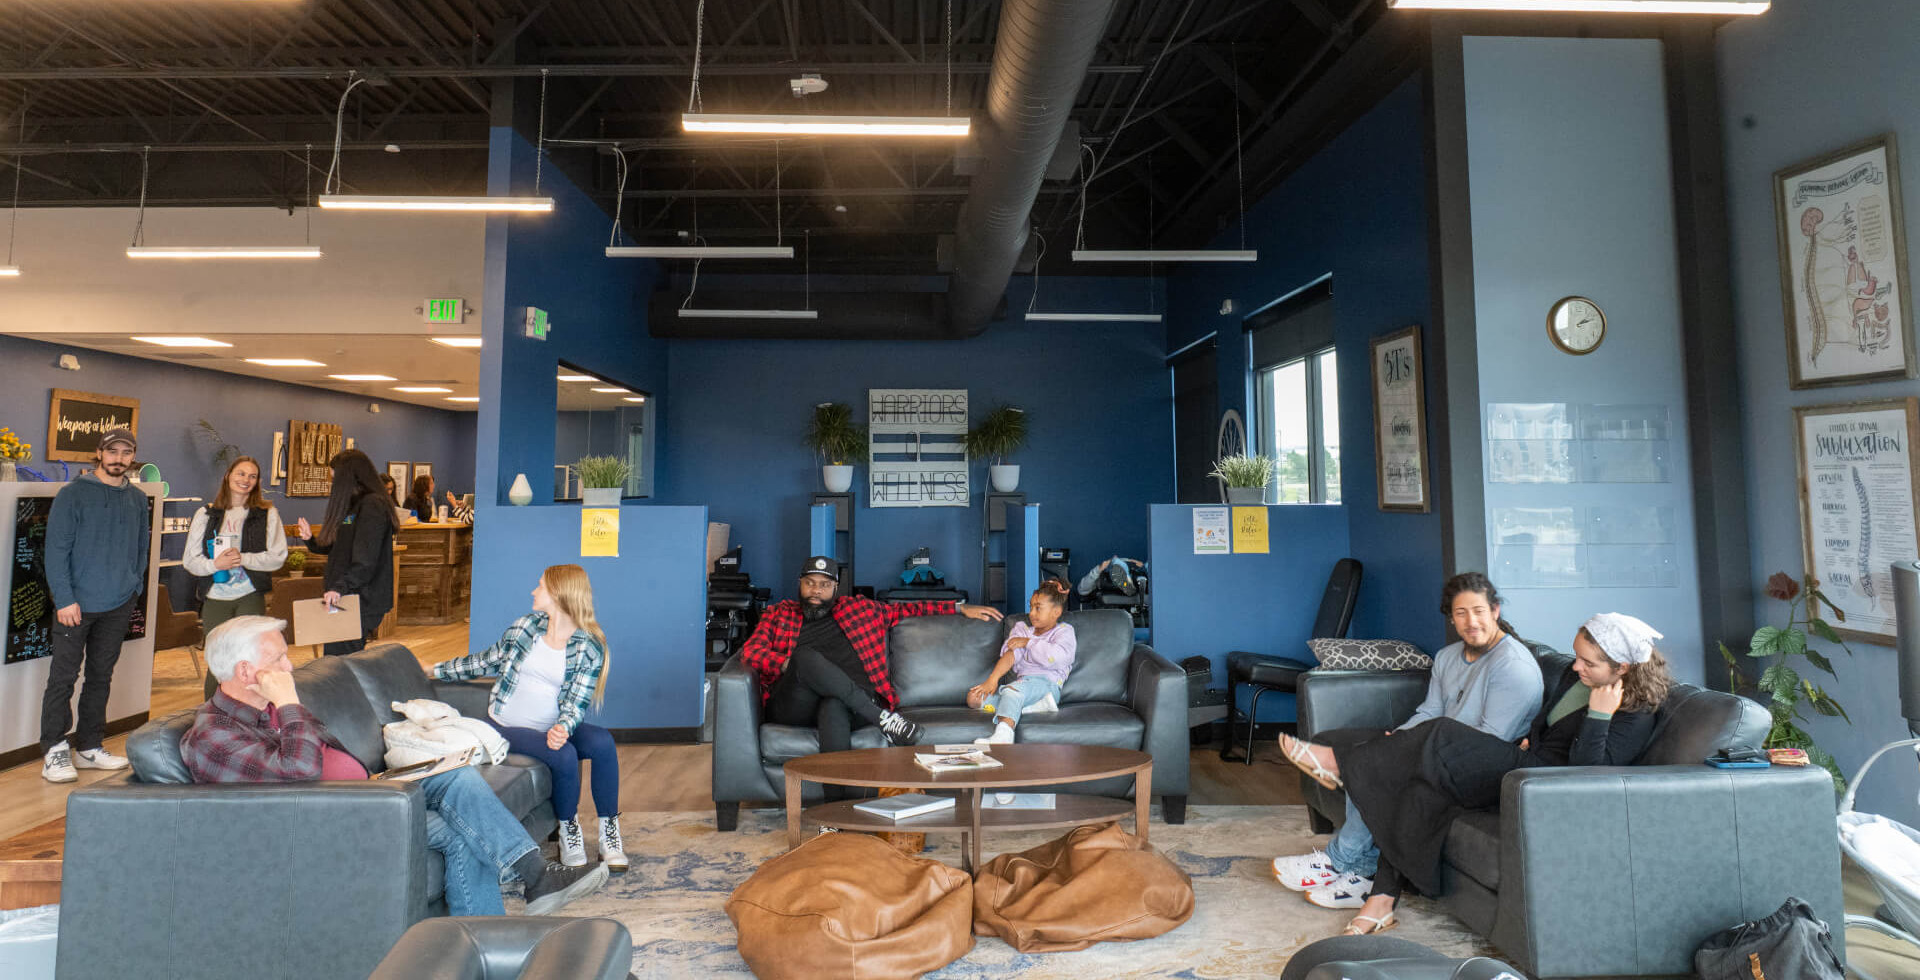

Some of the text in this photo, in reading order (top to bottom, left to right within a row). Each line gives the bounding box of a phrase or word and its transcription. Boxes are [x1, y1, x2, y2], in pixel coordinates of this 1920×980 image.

[430, 299, 457, 320] EXIT
[871, 394, 967, 424] WARRIORS
[57, 414, 92, 442] Weapons
[300, 431, 342, 465] WOW
[303, 467, 329, 479] FAMILY
[872, 471, 968, 502] WELLNESS
